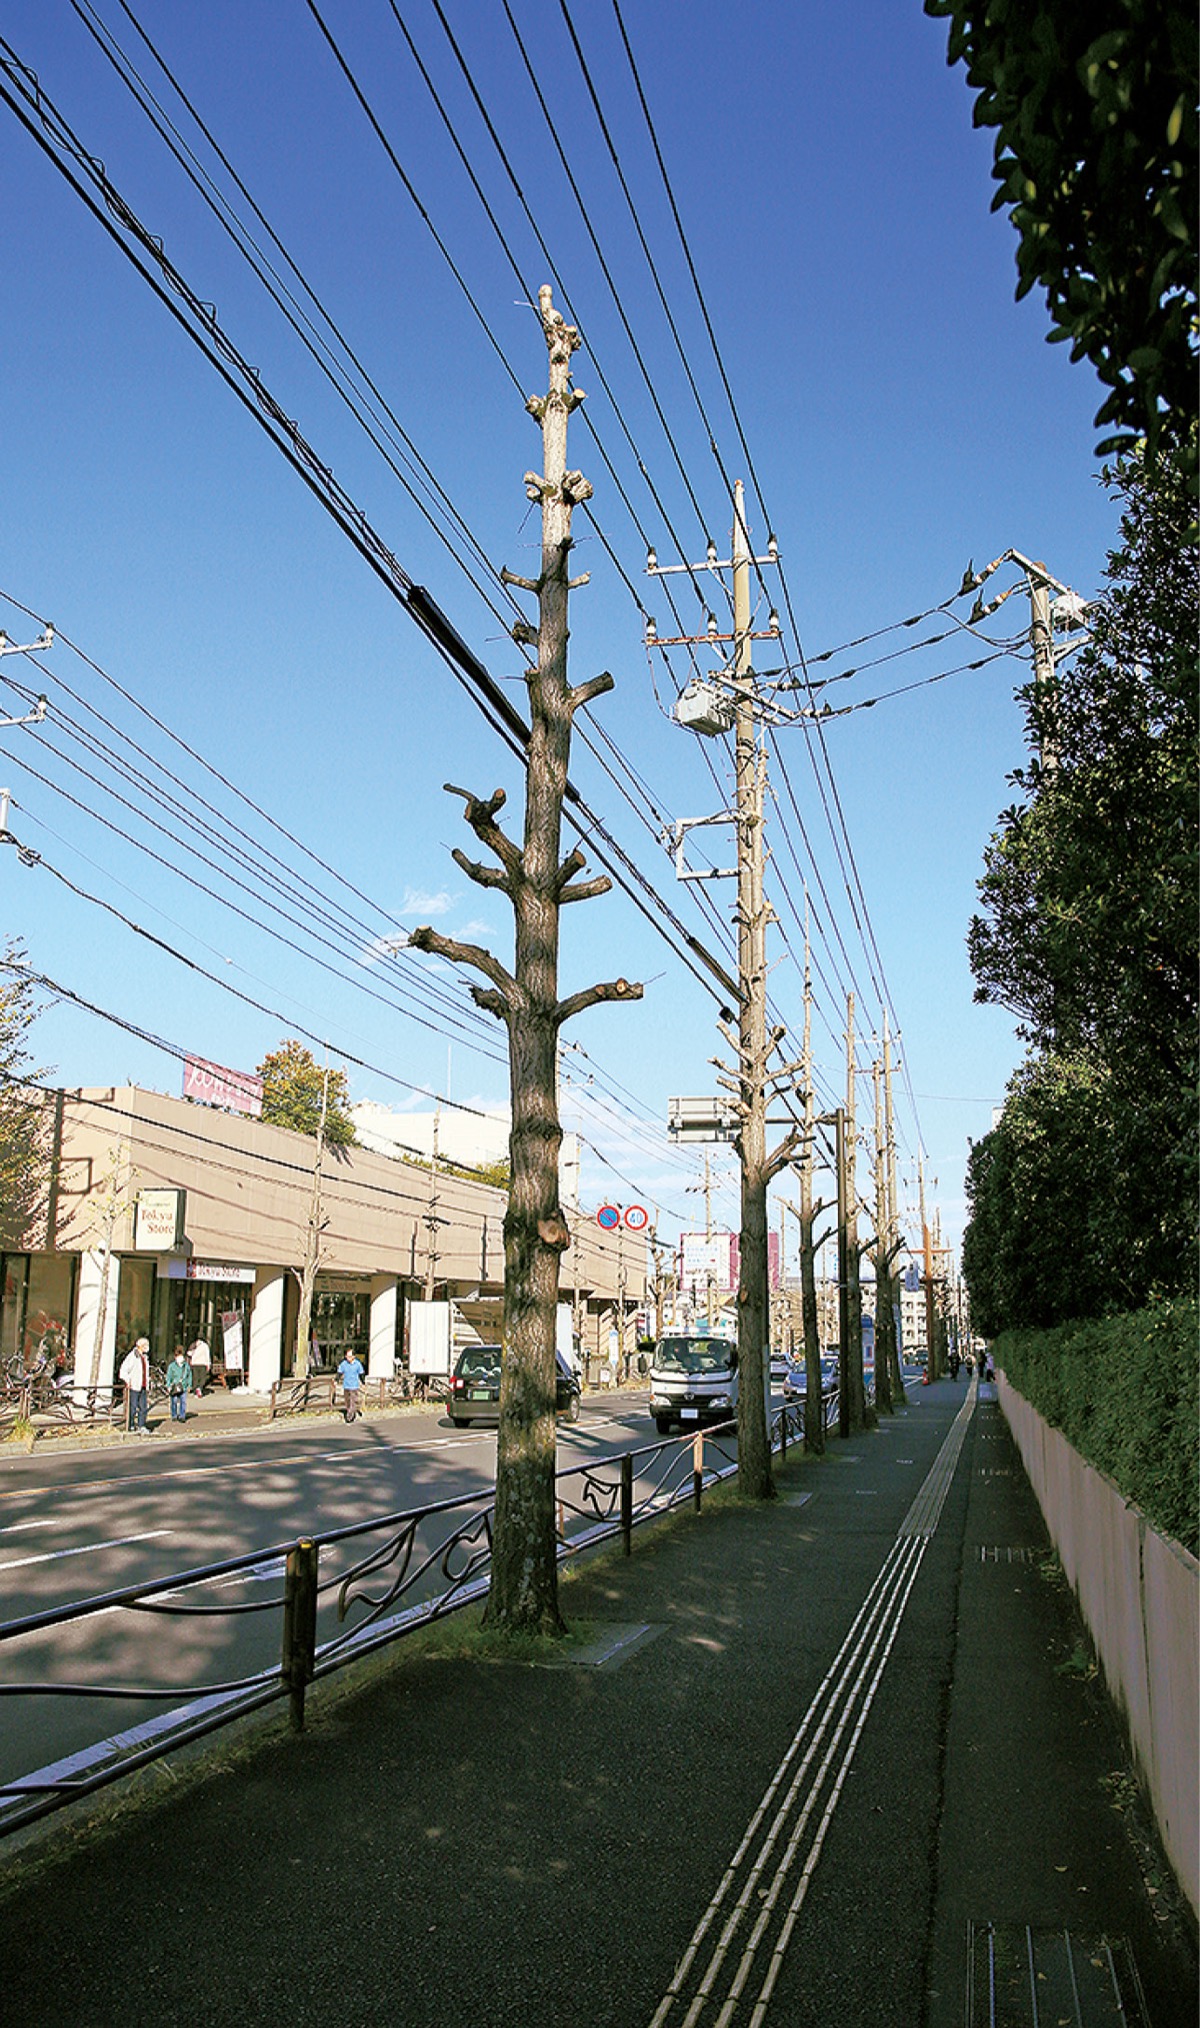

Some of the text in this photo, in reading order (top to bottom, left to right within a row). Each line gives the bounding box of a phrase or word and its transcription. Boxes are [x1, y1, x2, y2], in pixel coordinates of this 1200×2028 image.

[141, 1208, 173, 1222] Tokyu
[630, 1212, 643, 1224] 40
[147, 1222, 175, 1234] Store
